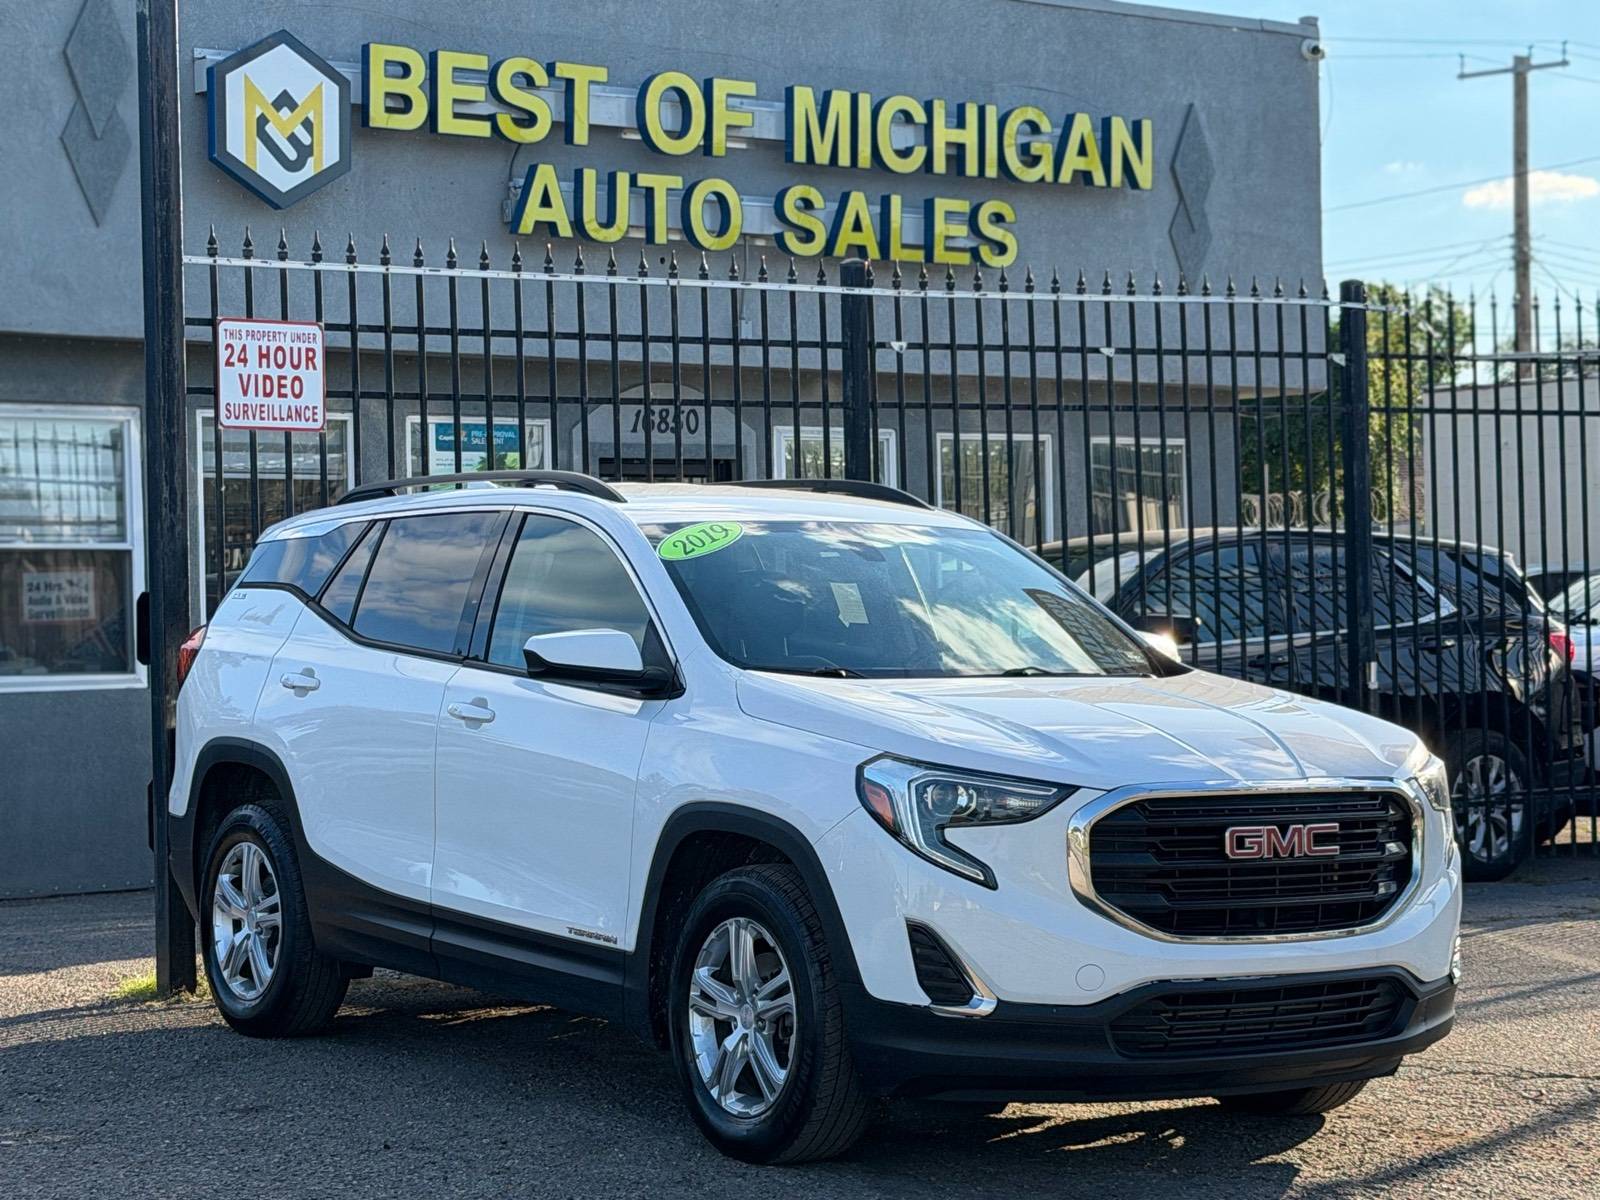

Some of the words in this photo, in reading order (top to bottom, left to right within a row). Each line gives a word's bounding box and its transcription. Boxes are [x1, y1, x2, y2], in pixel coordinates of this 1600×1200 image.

[361, 42, 608, 146] BEST
[635, 71, 757, 157] OF
[785, 85, 1153, 190] MICHIGAN
[510, 163, 743, 251] AUTO
[774, 184, 1018, 268] SALES
[224, 328, 243, 341] THIS
[245, 329, 288, 343] PROPERTY
[290, 332, 318, 345] UNDER
[224, 343, 249, 368] 24
[258, 344, 318, 371] HOUR
[238, 373, 304, 399] VIDEO
[225, 402, 319, 423] SURVEILLANCE
[672, 524, 733, 555] 2019
[1225, 823, 1340, 858] GMC
